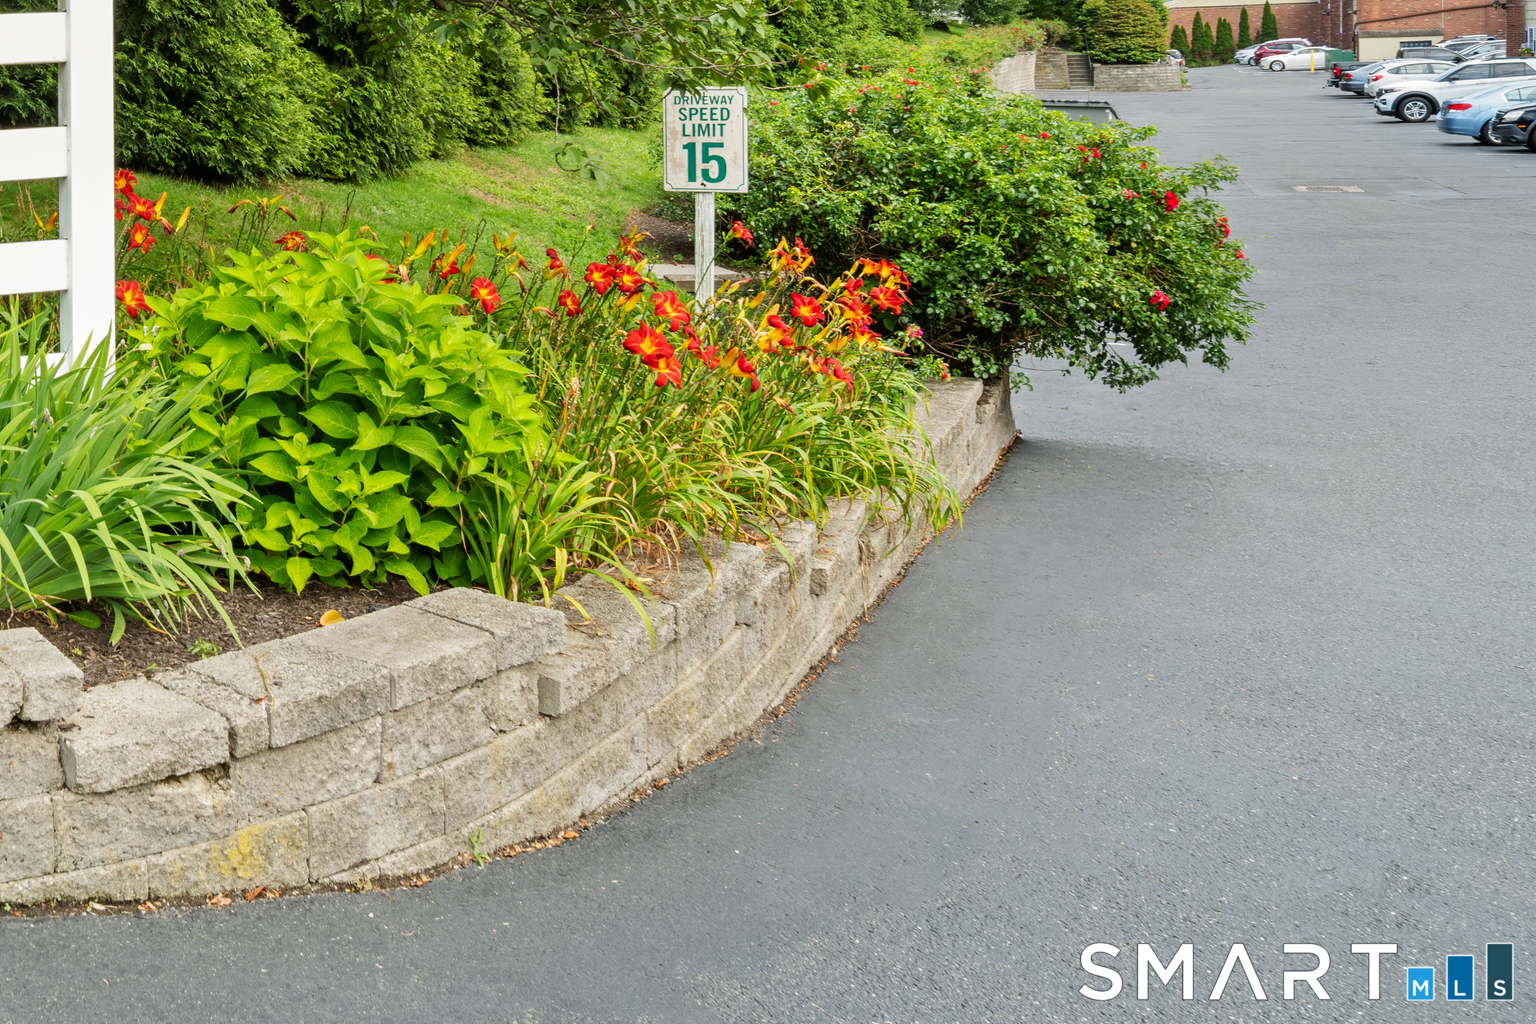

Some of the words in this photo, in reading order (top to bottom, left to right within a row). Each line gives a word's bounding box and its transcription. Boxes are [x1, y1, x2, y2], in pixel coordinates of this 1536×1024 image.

[674, 95, 734, 105] DRIVEWAY
[678, 107, 730, 121] SPEED
[682, 123, 726, 137] LIMIT
[682, 142, 727, 183] 15
